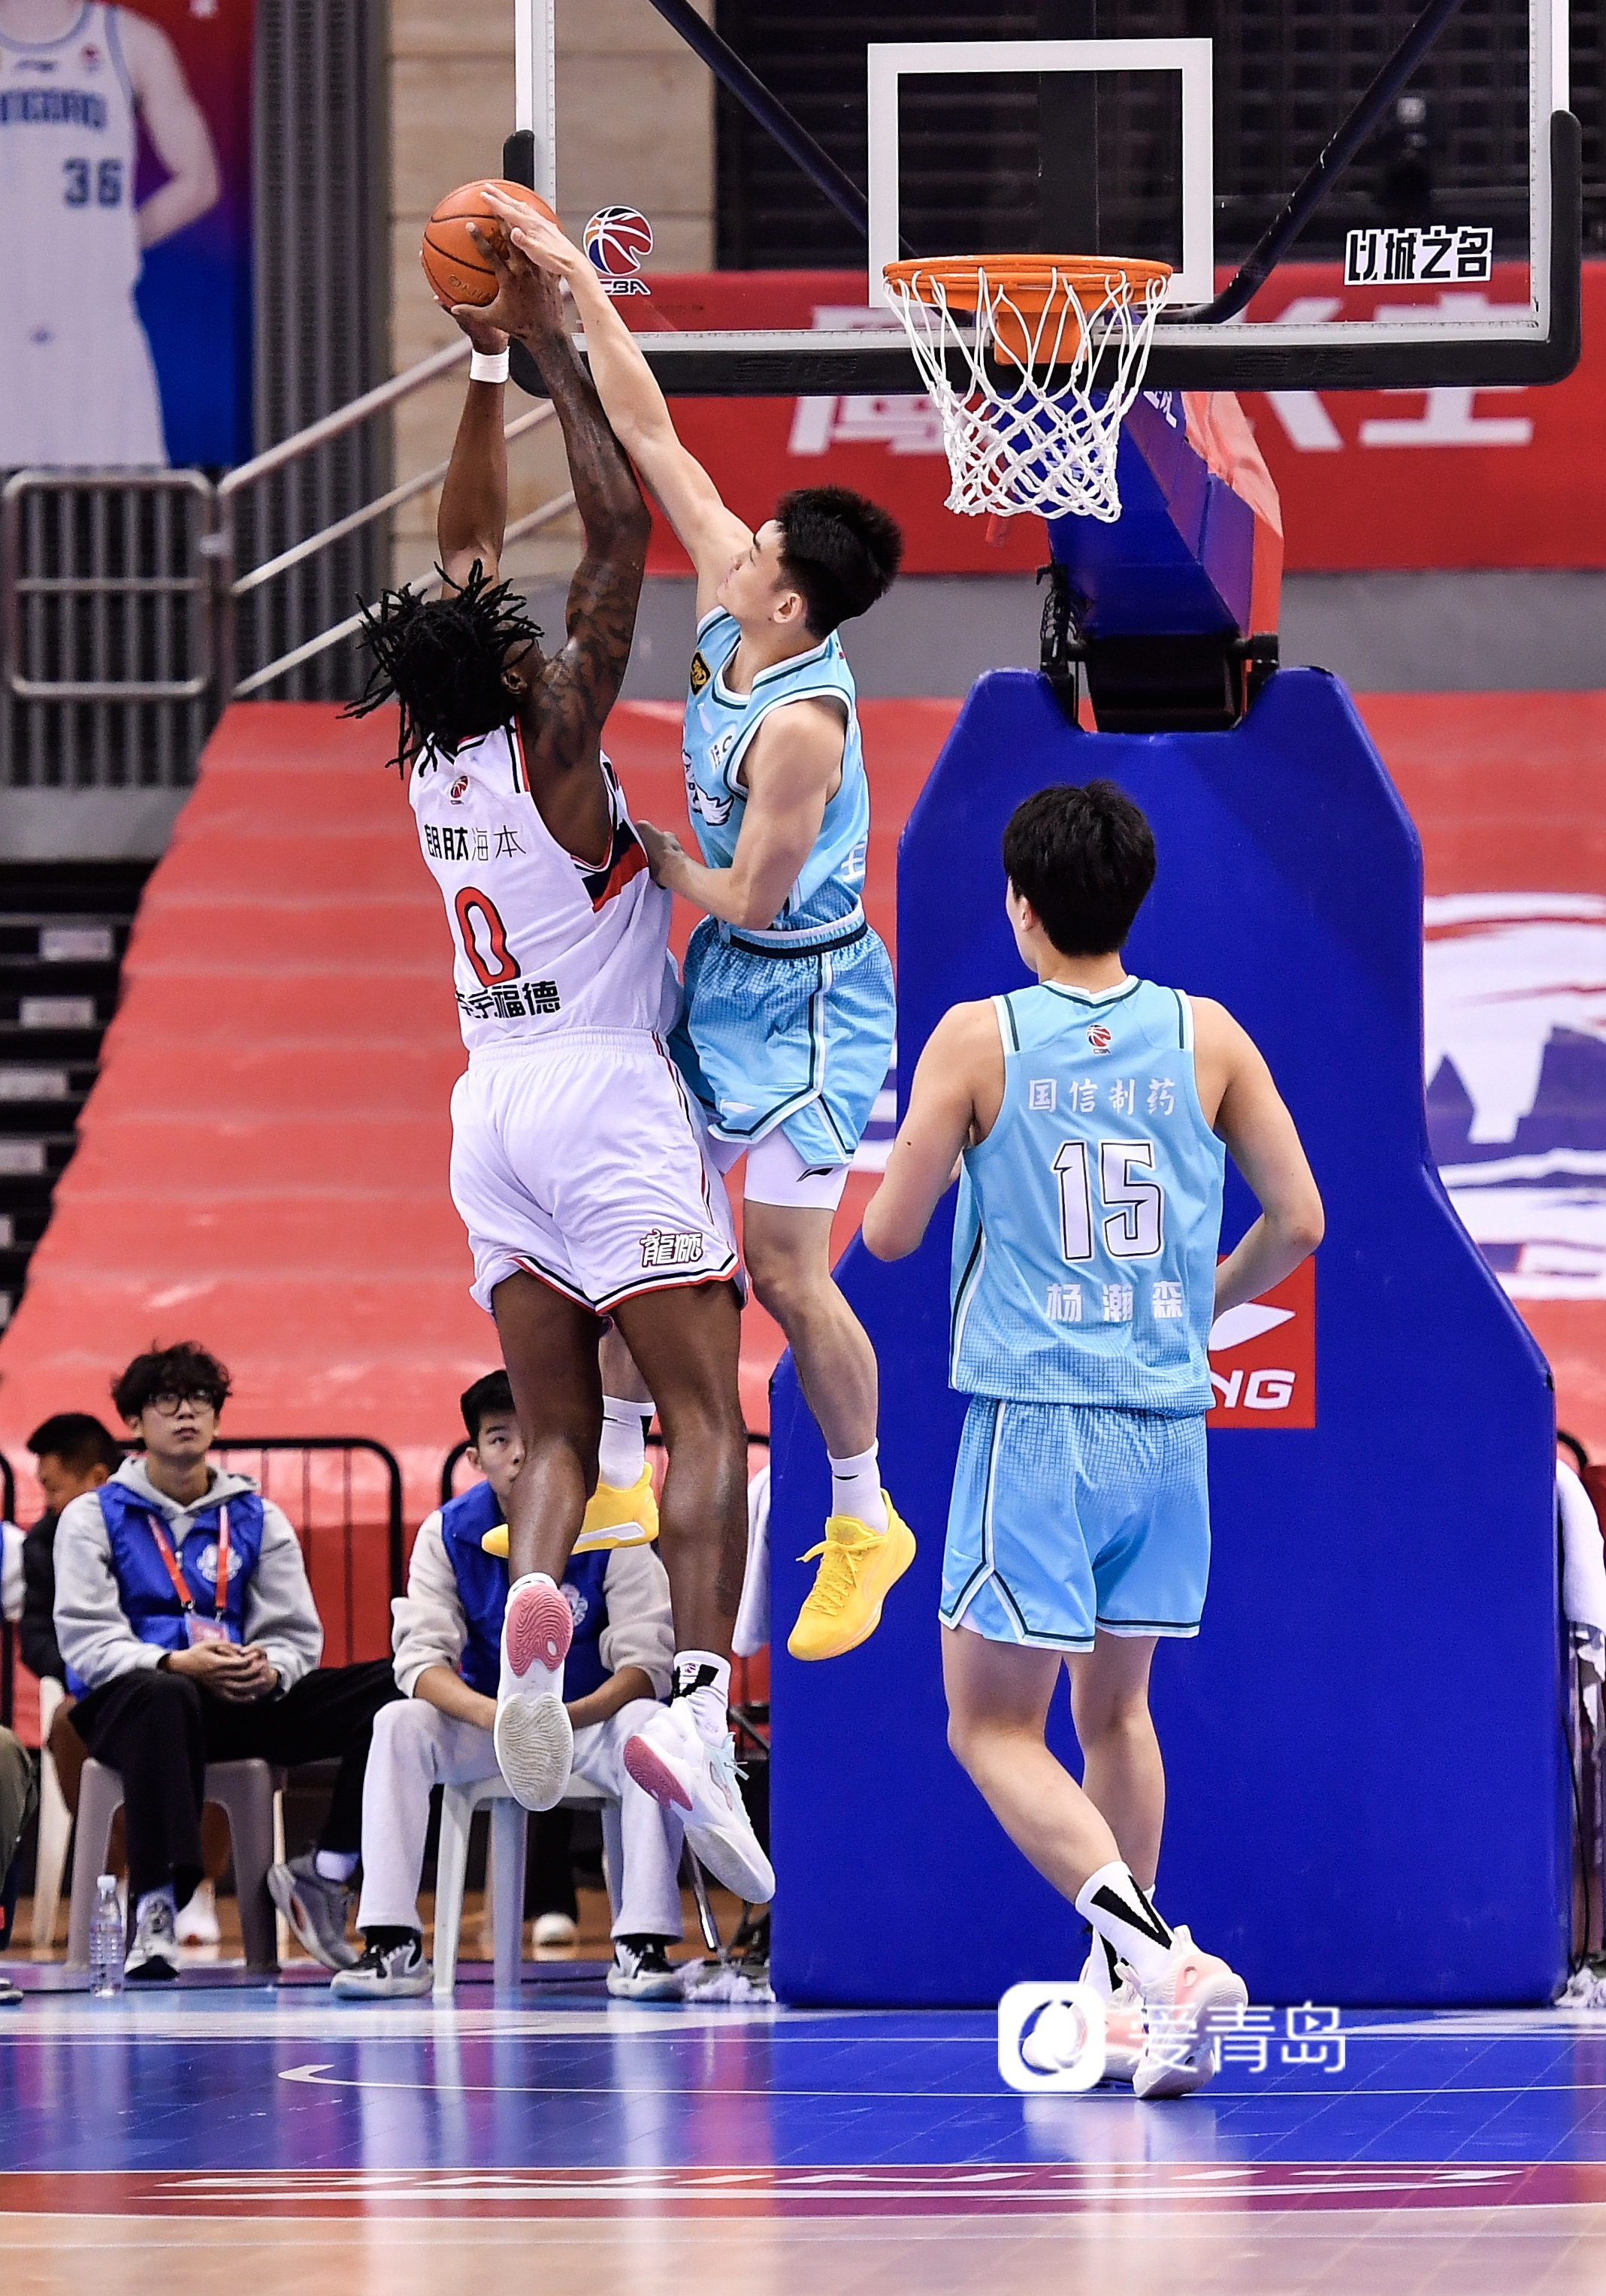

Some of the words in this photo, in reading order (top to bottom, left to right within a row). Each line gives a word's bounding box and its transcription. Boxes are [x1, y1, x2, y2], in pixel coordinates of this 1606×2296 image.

[63, 158, 122, 209] 36
[1347, 228, 1490, 282] 以城之名
[454, 886, 522, 989] 0
[1029, 1078, 1175, 1116] 国信制药
[1051, 1139, 1164, 1263] 15
[1045, 1280, 1184, 1322] 杨瀚森
